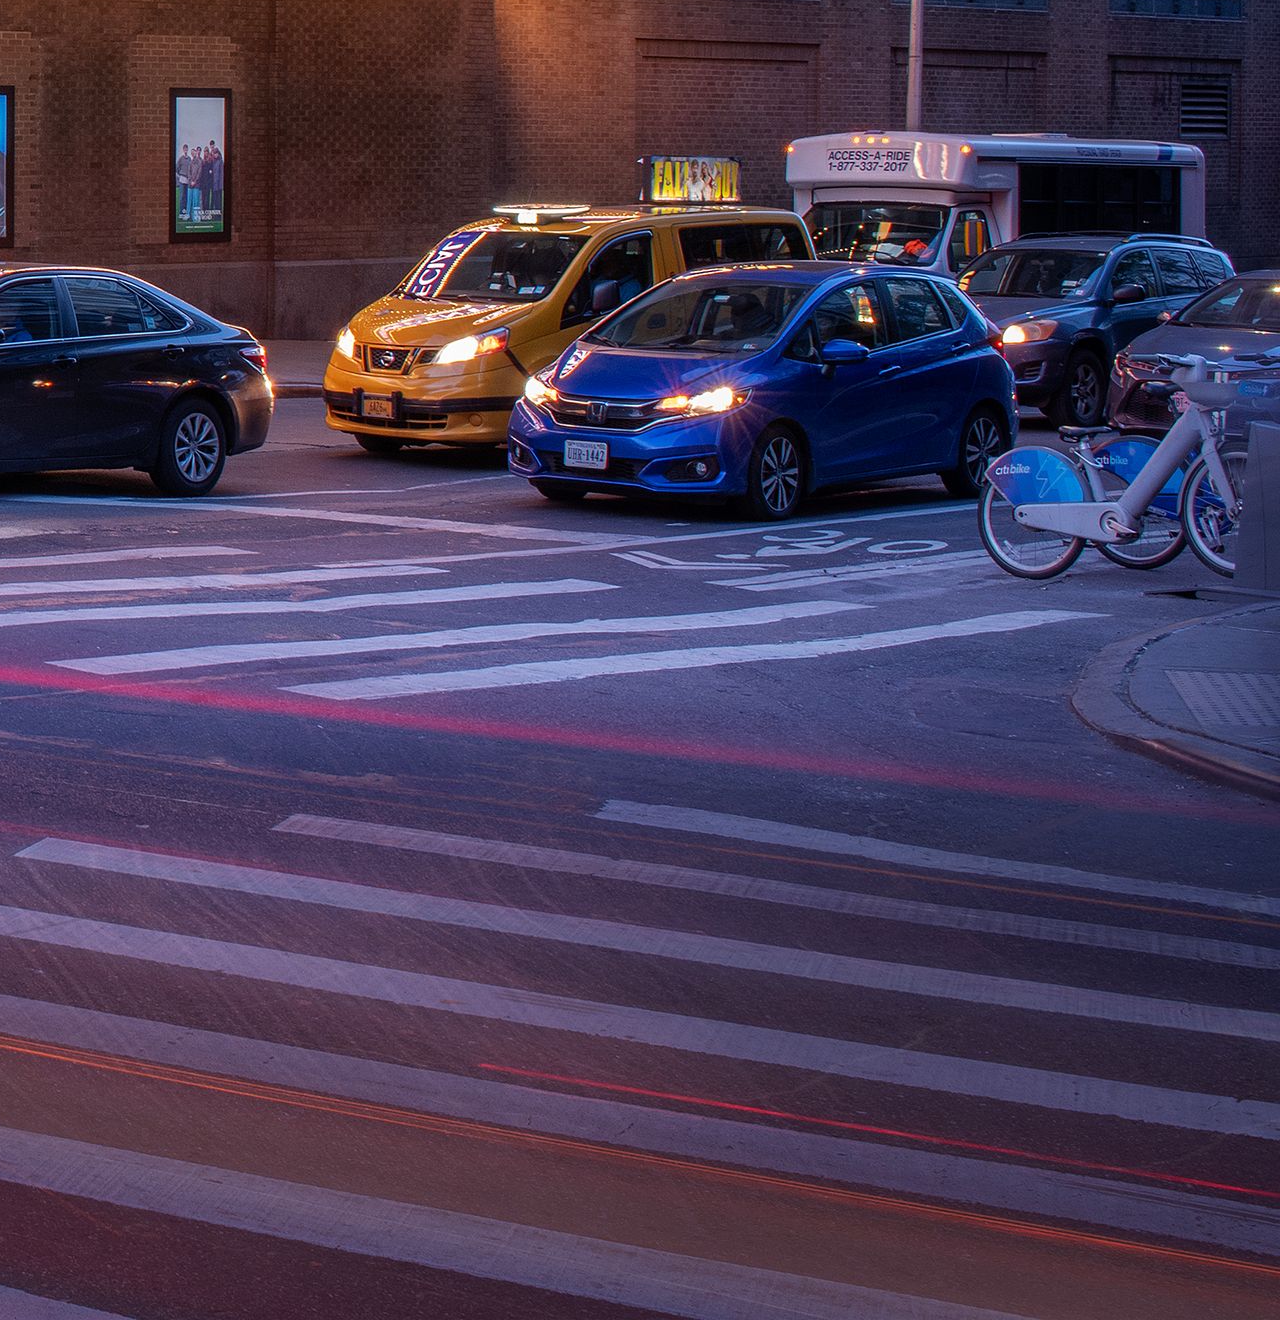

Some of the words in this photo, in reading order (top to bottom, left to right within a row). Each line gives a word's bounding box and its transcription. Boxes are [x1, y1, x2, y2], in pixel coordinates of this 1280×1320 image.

[828, 150, 911, 161] ACCESS-A-RIDE
[828, 161, 909, 172] 1-877-337-2017
[567, 448, 605, 462] UHR-1442
